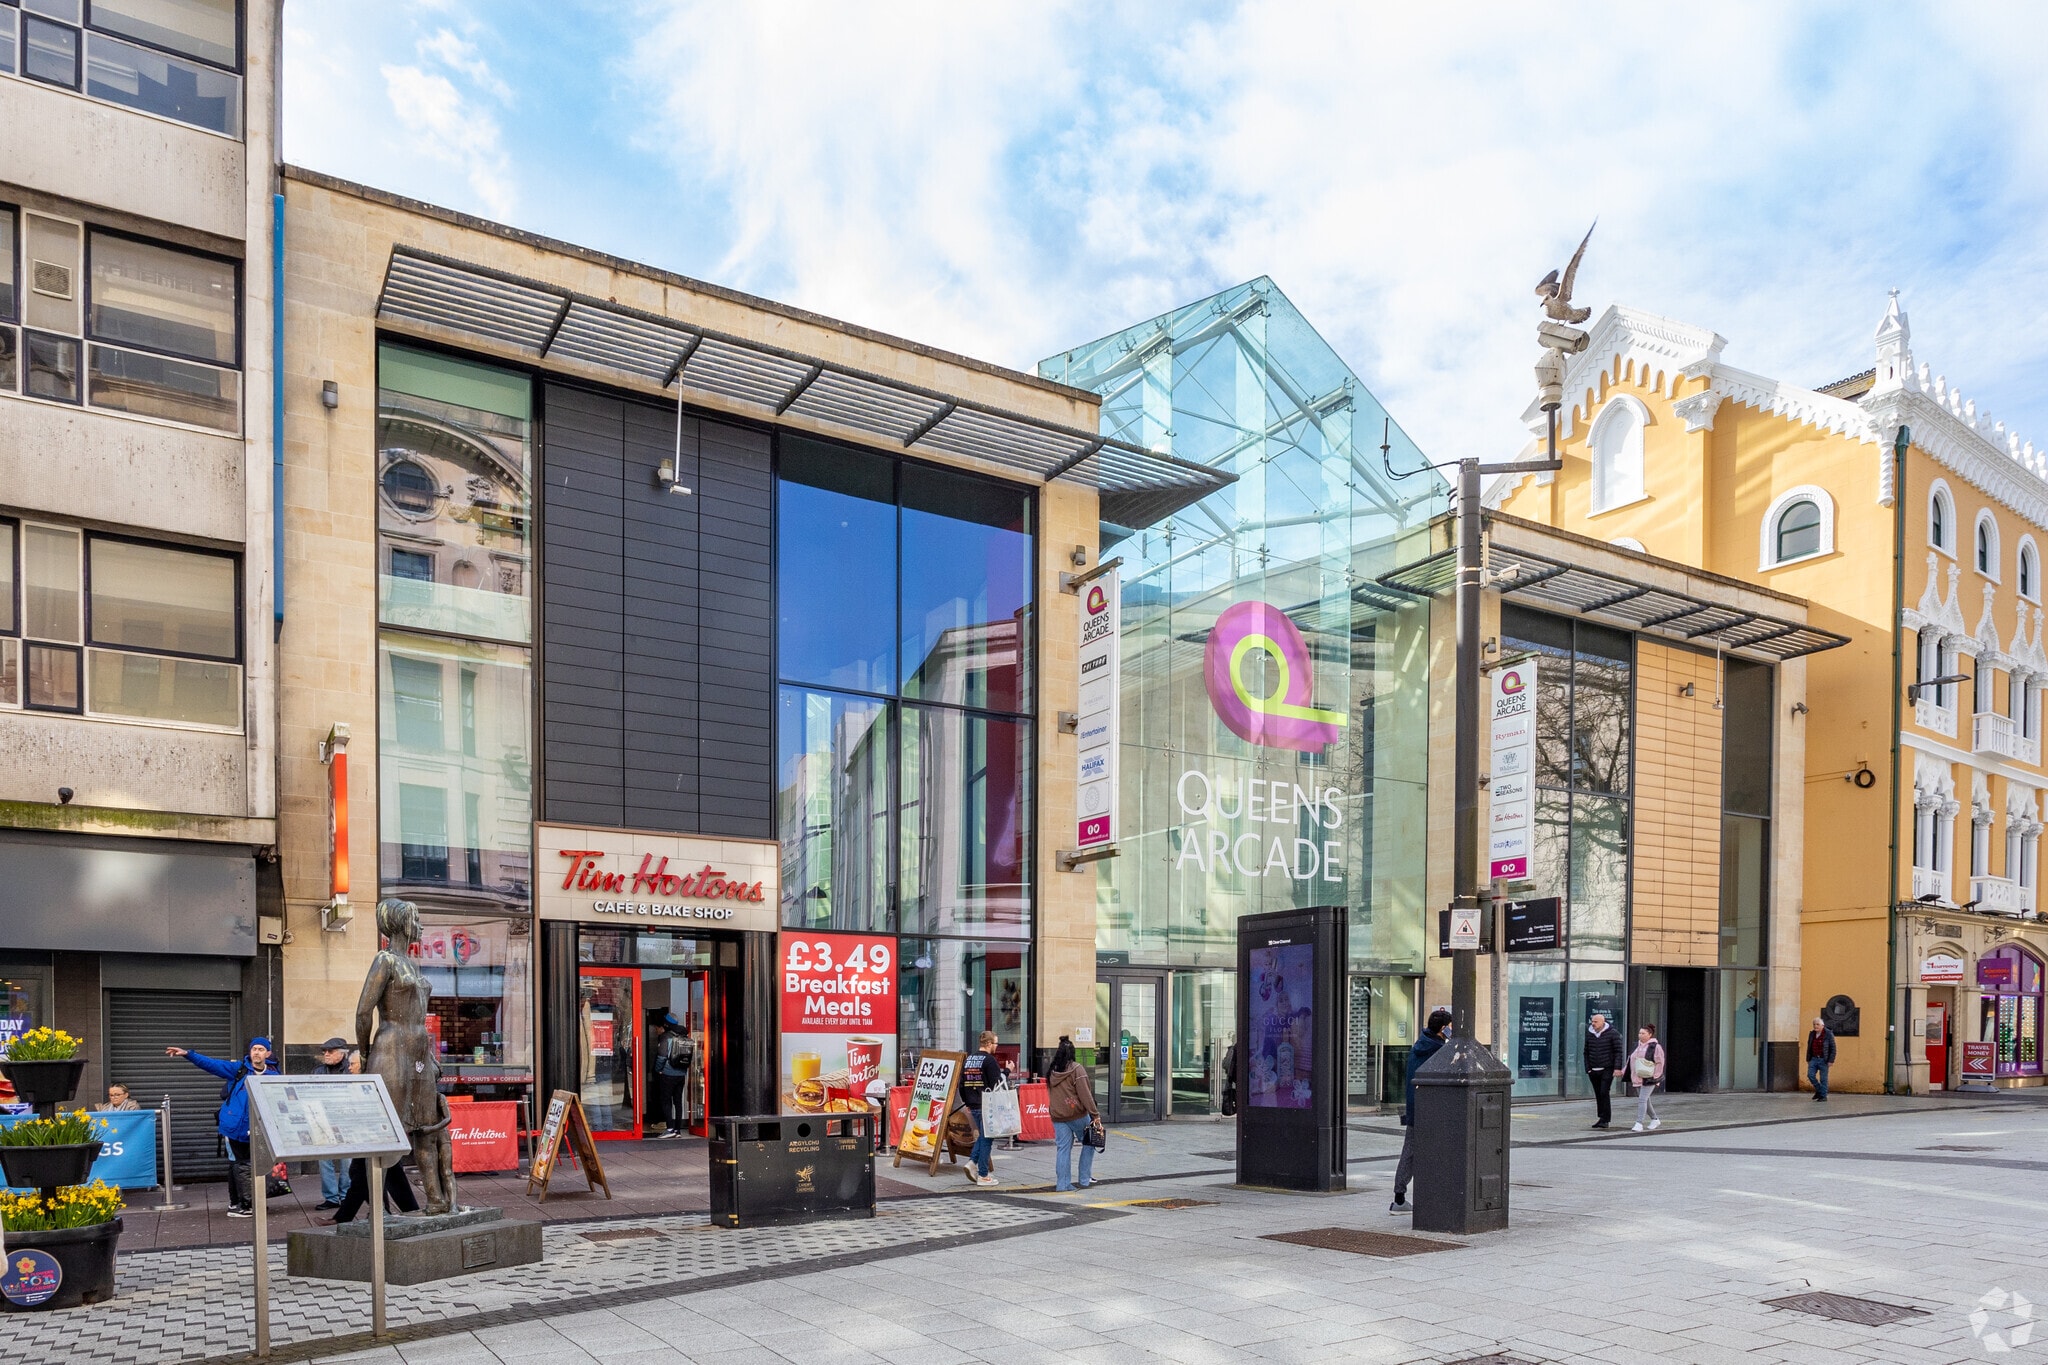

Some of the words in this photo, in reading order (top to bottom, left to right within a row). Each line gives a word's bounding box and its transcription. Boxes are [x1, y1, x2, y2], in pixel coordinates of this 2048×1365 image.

[1083, 612, 1109, 632] QUEENS
[1083, 623, 1109, 643] ARCADE
[1496, 693, 1527, 708] QUEENS
[1496, 702, 1526, 717] ARCADE
[1495, 729, 1526, 741] Ryman
[1081, 758, 1105, 772] HALIFAX
[1500, 787, 1523, 796] SEASONS
[1177, 770, 1343, 830] QUEENS
[1176, 828, 1343, 883] ARCADE
[559, 850, 626, 894] Tim
[637, 904, 648, 915] &
[651, 903, 691, 918] BAKE
[694, 906, 734, 920] SHOP
[785, 941, 891, 974] £3.49
[785, 973, 891, 995] Breakfast
[804, 995, 872, 1017] Meals
[802, 1017, 824, 1025] AVAILABLE
[825, 1017, 839, 1025] EVERY
[849, 1018, 862, 1026] UNTIL
[1263, 1016, 1299, 1026] GUCCI
[848, 1047, 871, 1067] Tim
[919, 1062, 950, 1080] £3.49
[917, 1079, 945, 1092] Breakfast
[914, 1091, 932, 1102] Meals
[1025, 1104, 1038, 1114] Tim
[450, 1128, 467, 1140] Tim
